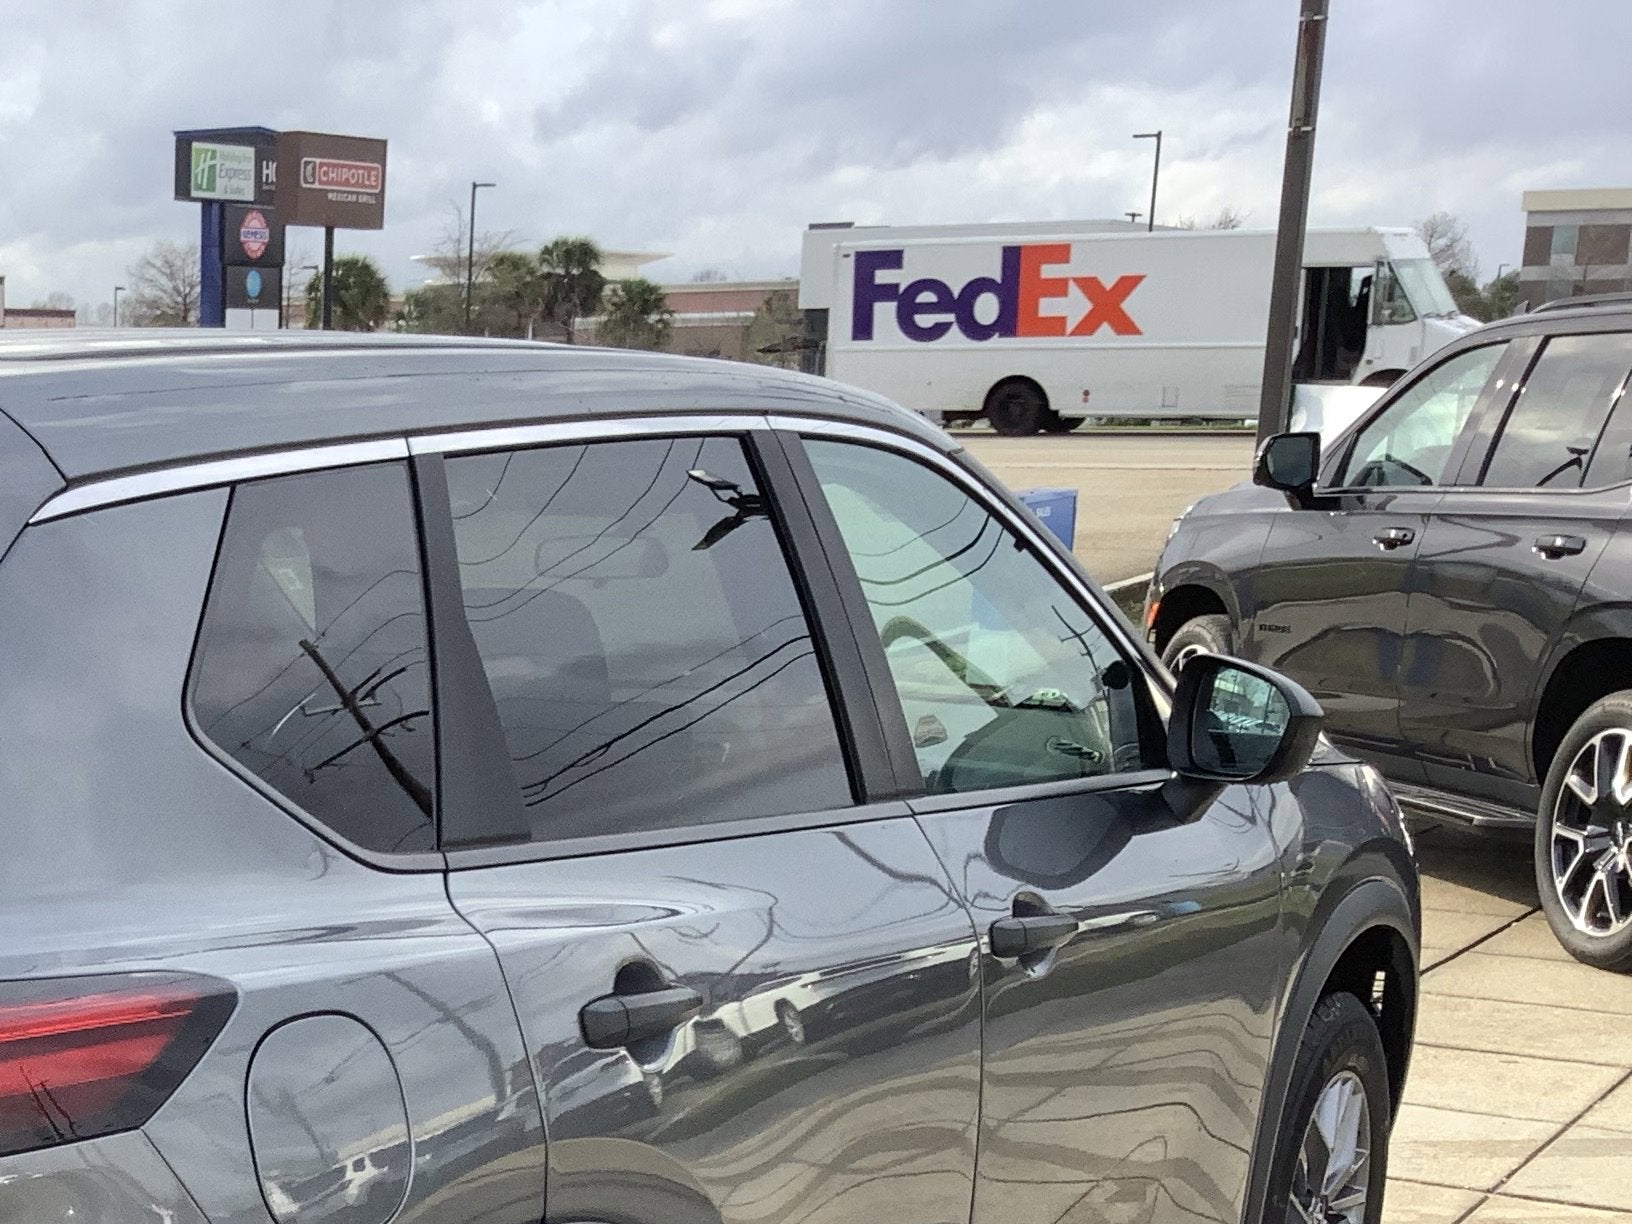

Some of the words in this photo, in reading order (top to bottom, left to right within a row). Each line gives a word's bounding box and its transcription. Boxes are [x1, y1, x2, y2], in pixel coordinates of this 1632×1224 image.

[218, 163, 253, 182] Express
[320, 166, 378, 186] CHIPOTLE
[851, 243, 1147, 342] FedEx
